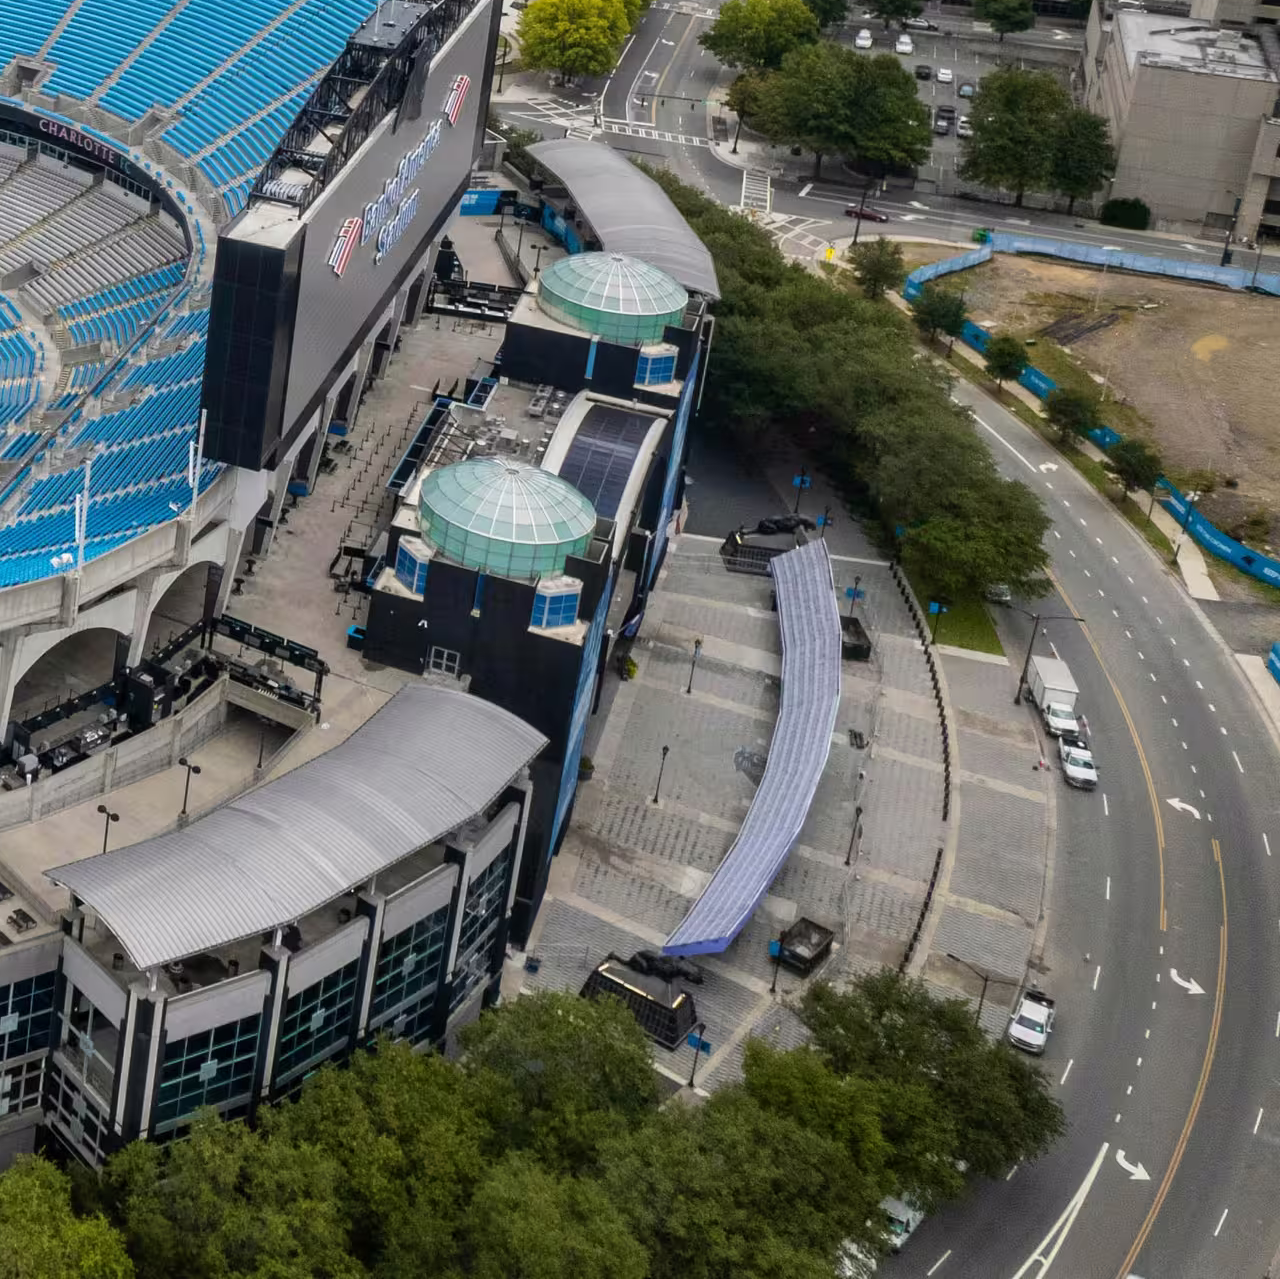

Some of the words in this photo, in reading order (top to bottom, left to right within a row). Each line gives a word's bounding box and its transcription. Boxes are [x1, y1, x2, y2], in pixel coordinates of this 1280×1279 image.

[40, 119, 115, 163] CHARLOTTE
[119, 157, 131, 174] FC
[361, 179, 390, 246] Bank
[404, 119, 443, 188] America
[376, 188, 420, 265] Stadium
